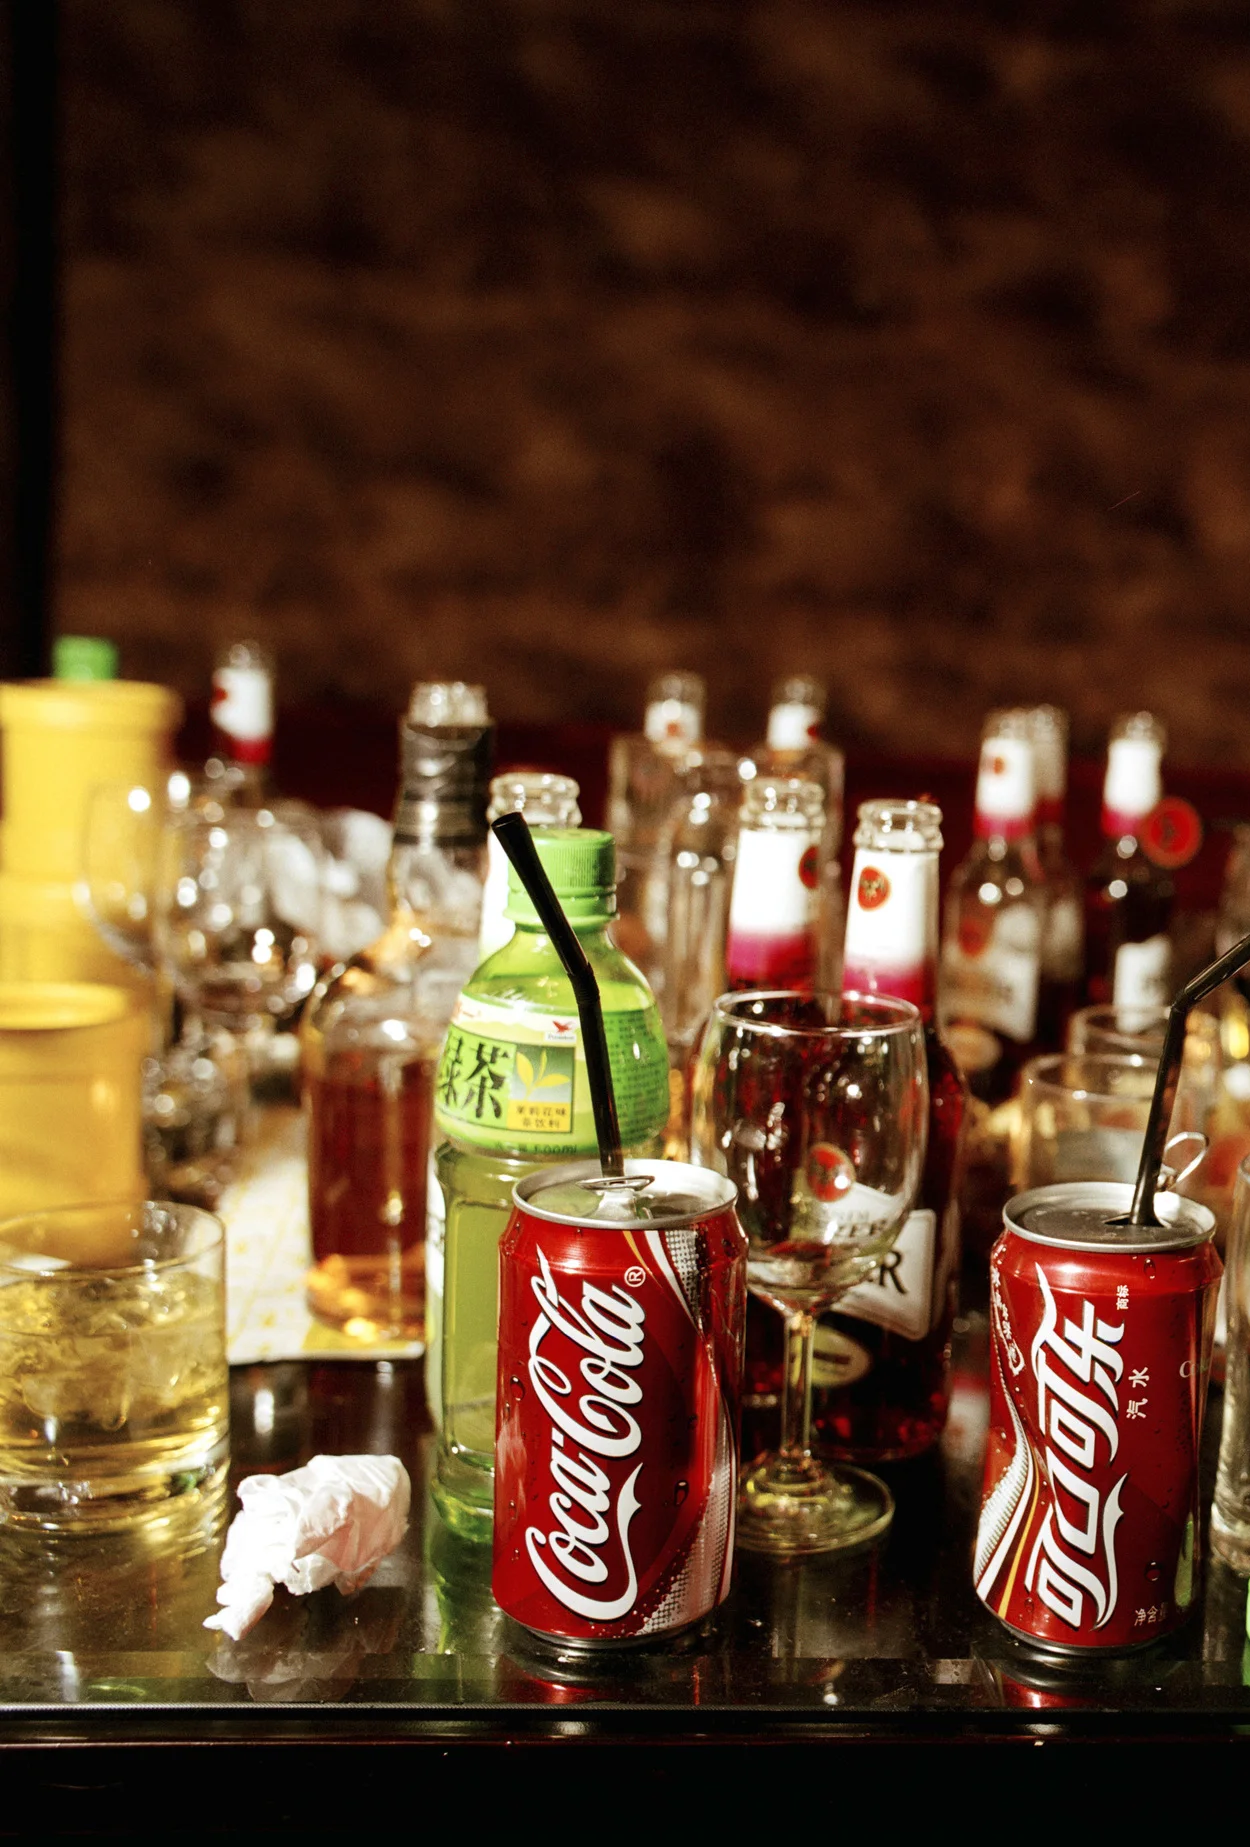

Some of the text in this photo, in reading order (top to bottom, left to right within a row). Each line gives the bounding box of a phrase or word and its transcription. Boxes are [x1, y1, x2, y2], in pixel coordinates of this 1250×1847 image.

[1116, 1285, 1130, 1311] 商标
[1126, 1366, 1150, 1420] 汽水
[526, 1243, 647, 1622] Coca-Cola
[1023, 1261, 1126, 1632] 可口可乐
